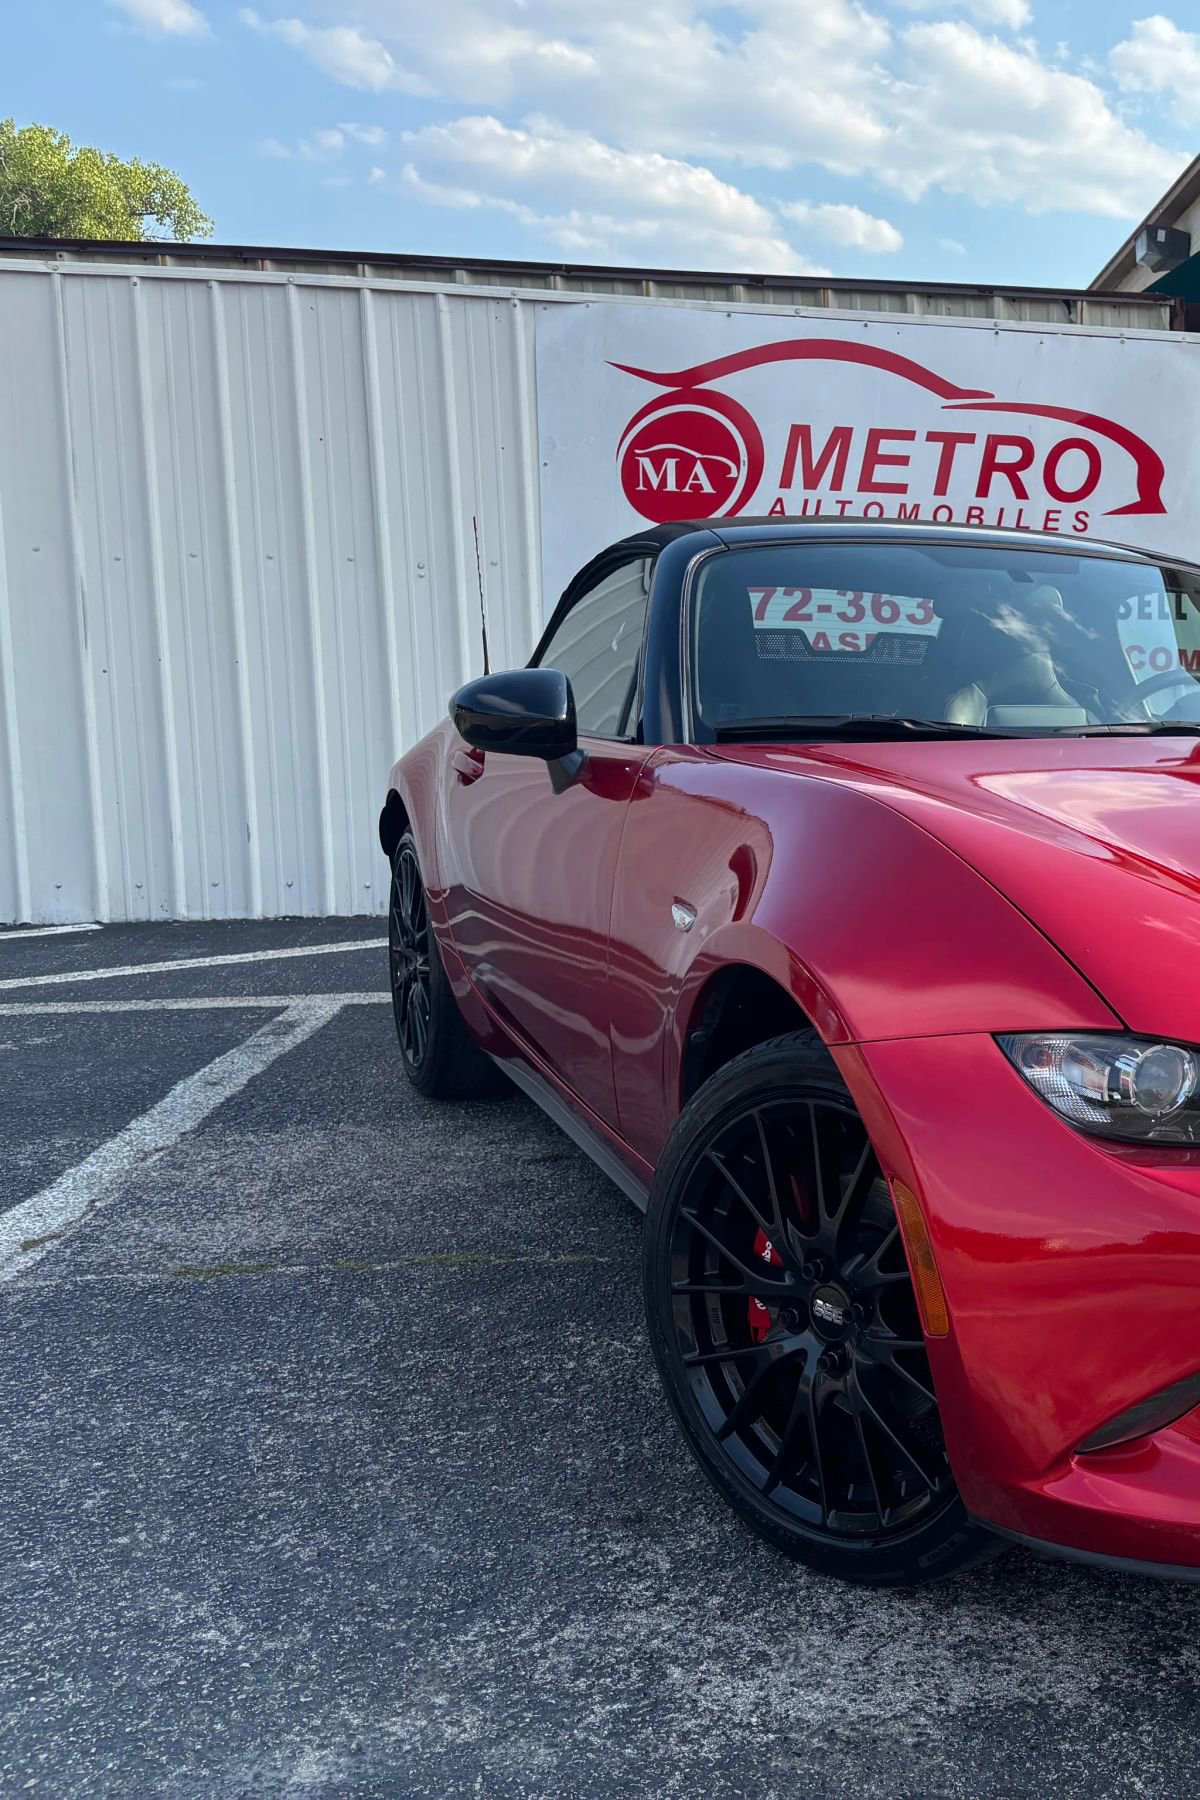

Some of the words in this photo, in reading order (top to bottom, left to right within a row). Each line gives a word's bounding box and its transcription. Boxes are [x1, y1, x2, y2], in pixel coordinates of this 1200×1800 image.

[634, 456, 717, 494] MA
[779, 424, 1102, 503] METRO
[768, 497, 1090, 532] AUTOMOBILES
[1117, 590, 1188, 621] SELL
